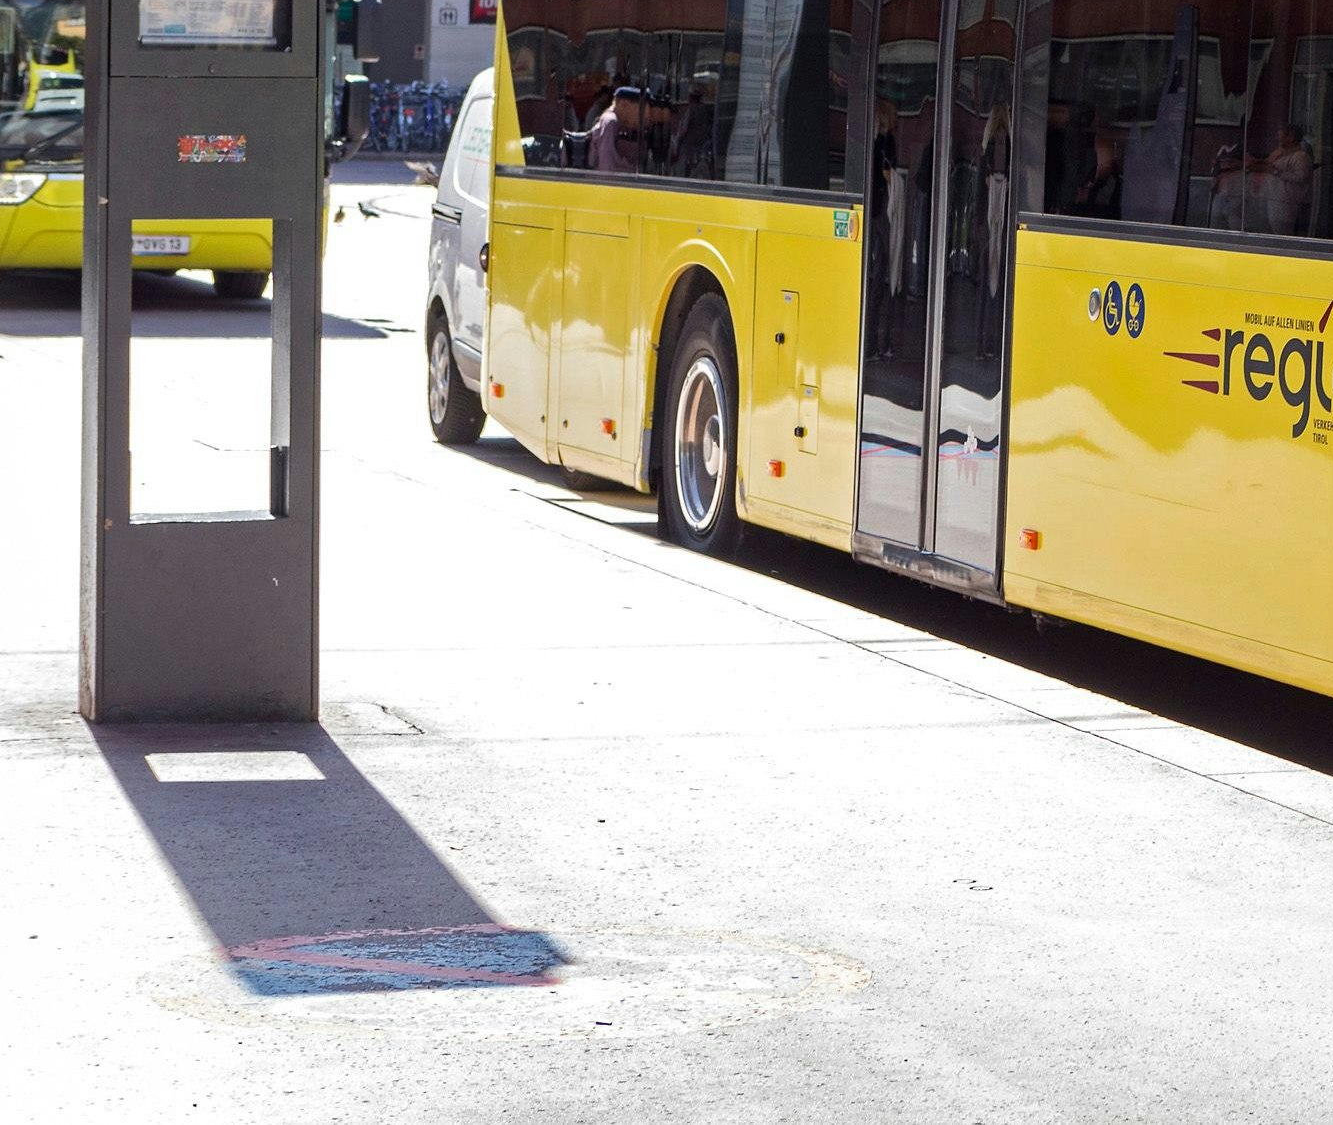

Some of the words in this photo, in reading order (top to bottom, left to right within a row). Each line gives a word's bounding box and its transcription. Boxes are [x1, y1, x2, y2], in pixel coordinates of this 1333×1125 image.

[1244, 312, 1263, 325] MOBIL
[1263, 315, 1276, 327] AUF
[1276, 317, 1294, 329] ALLEN
[1295, 319, 1315, 332] LINIEN
[1312, 432, 1328, 446] TIROL
